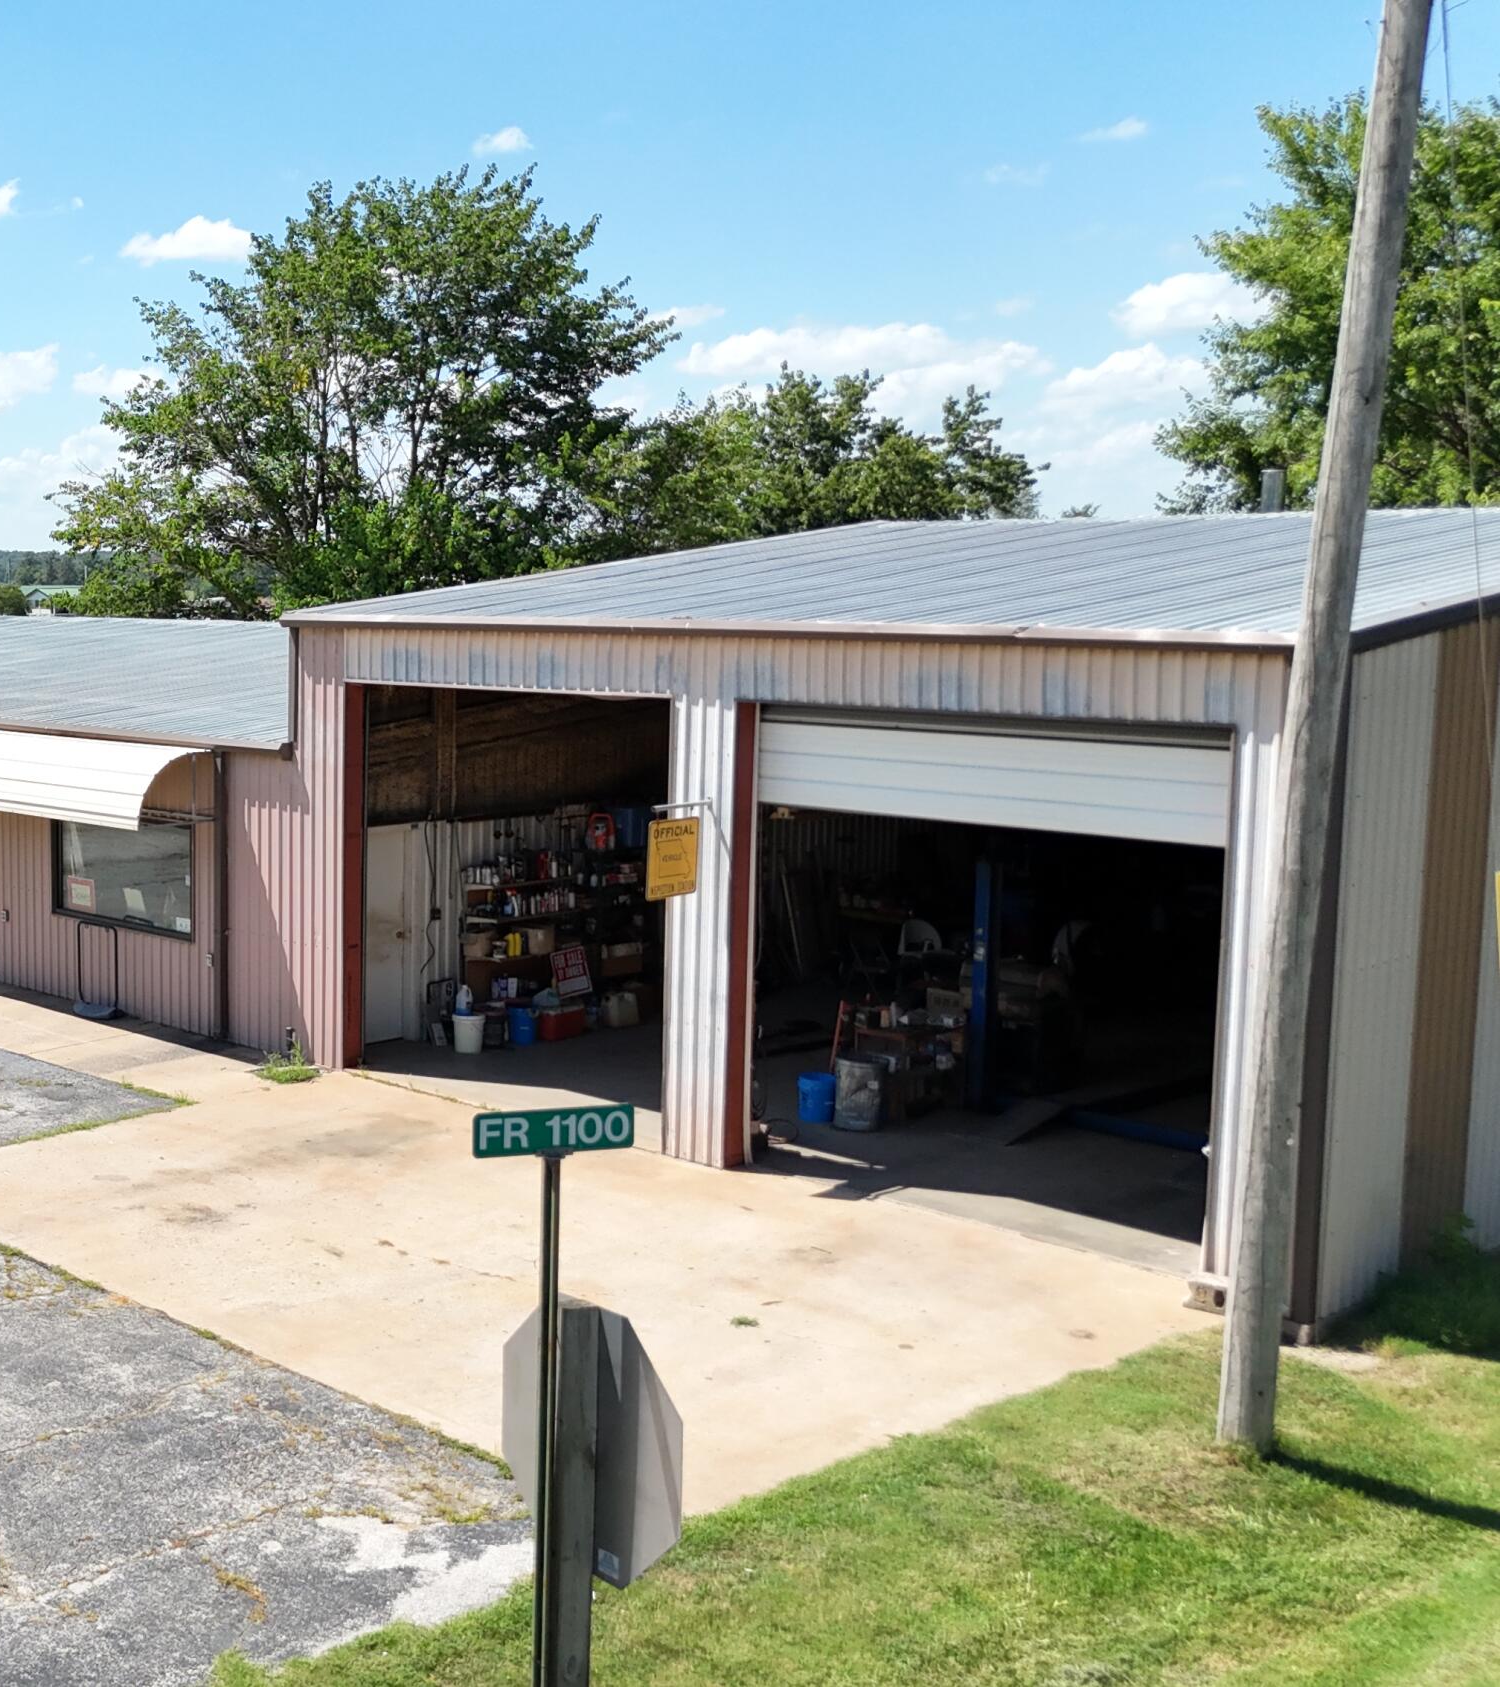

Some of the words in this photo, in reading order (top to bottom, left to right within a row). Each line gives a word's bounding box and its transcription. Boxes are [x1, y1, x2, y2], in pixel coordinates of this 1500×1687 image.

[653, 824, 694, 839] OFFICIAL
[479, 1117, 529, 1150] FR
[545, 1110, 630, 1147] 1100
